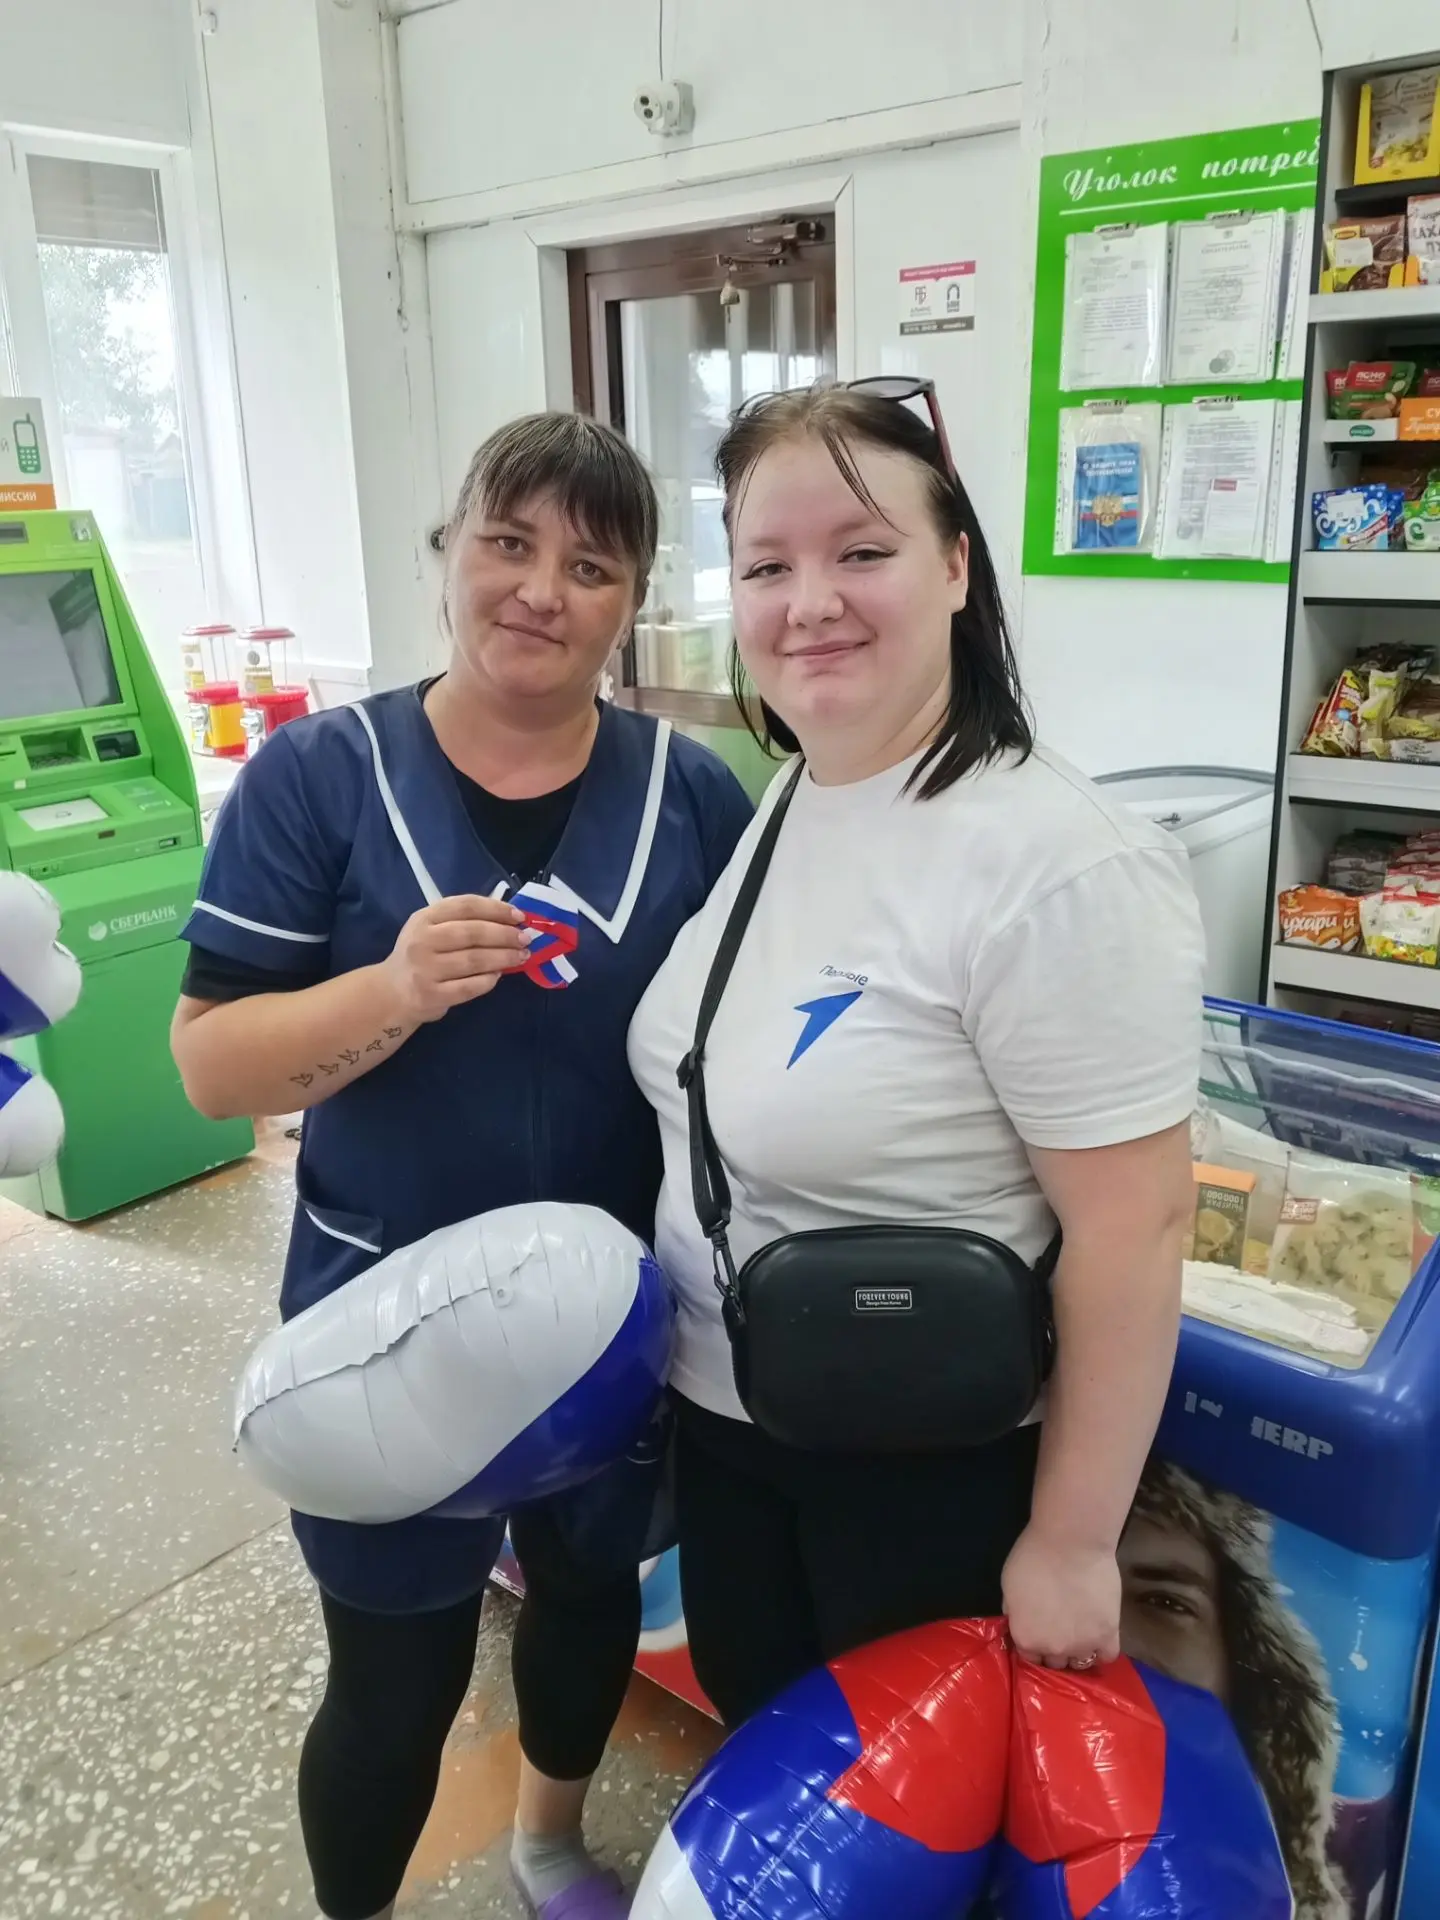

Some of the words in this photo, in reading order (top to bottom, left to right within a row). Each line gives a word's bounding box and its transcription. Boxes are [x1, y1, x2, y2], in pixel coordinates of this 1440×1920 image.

[1063, 164, 1178, 201] Уголок
[109, 904, 178, 932] СБЕРБАНК
[1282, 914, 1338, 938] ухари
[887, 1292, 909, 1300] YOUNG
